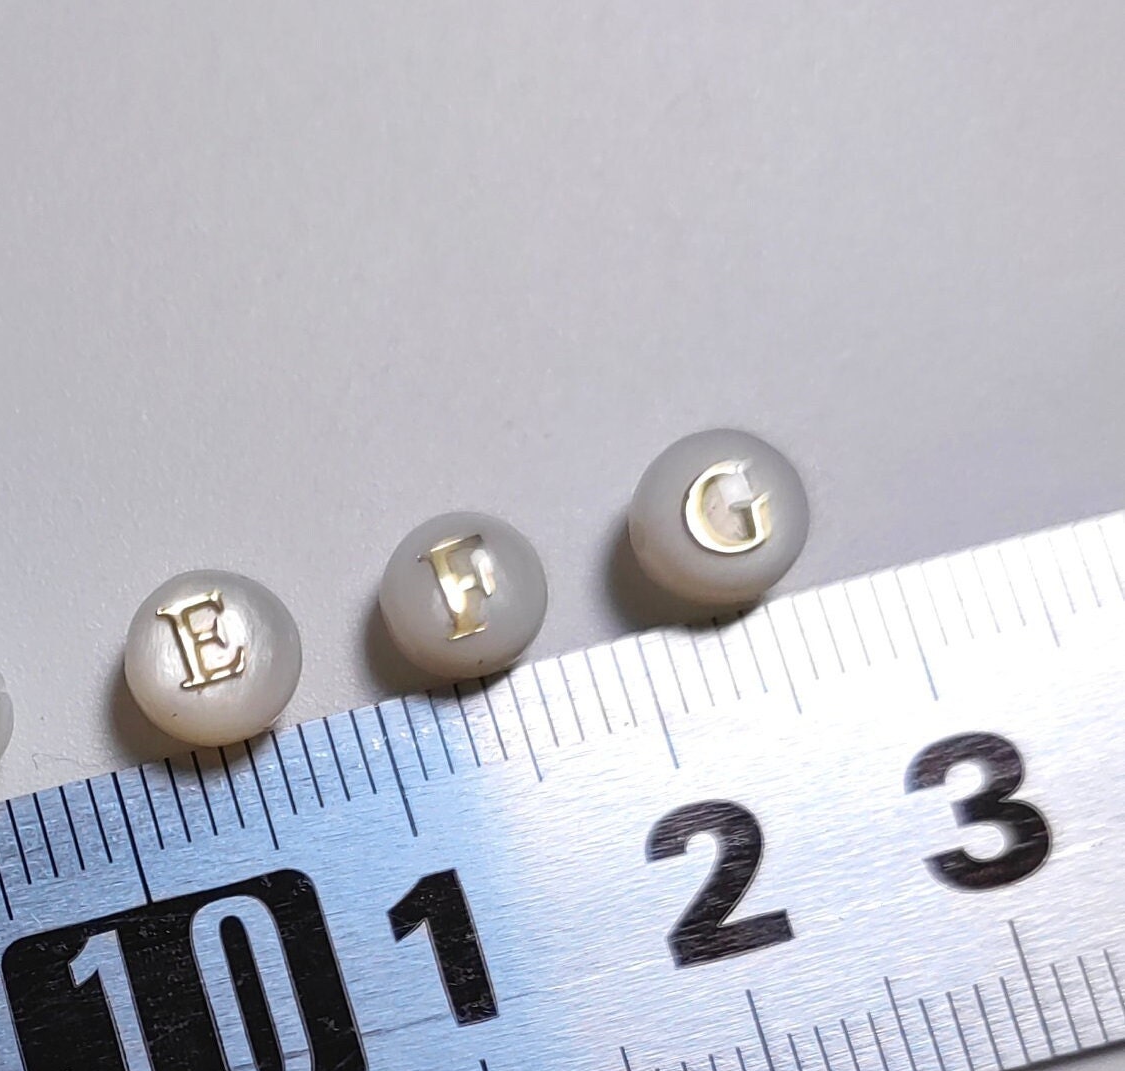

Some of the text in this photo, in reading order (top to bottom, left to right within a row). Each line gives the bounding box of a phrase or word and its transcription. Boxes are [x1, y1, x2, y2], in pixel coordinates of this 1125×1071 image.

[682, 458, 772, 554] G
[417, 534, 494, 640] F
[155, 590, 246, 689] E
[387, 869, 499, 1027] 1
[644, 799, 794, 969] 2
[902, 731, 1052, 893] 3
